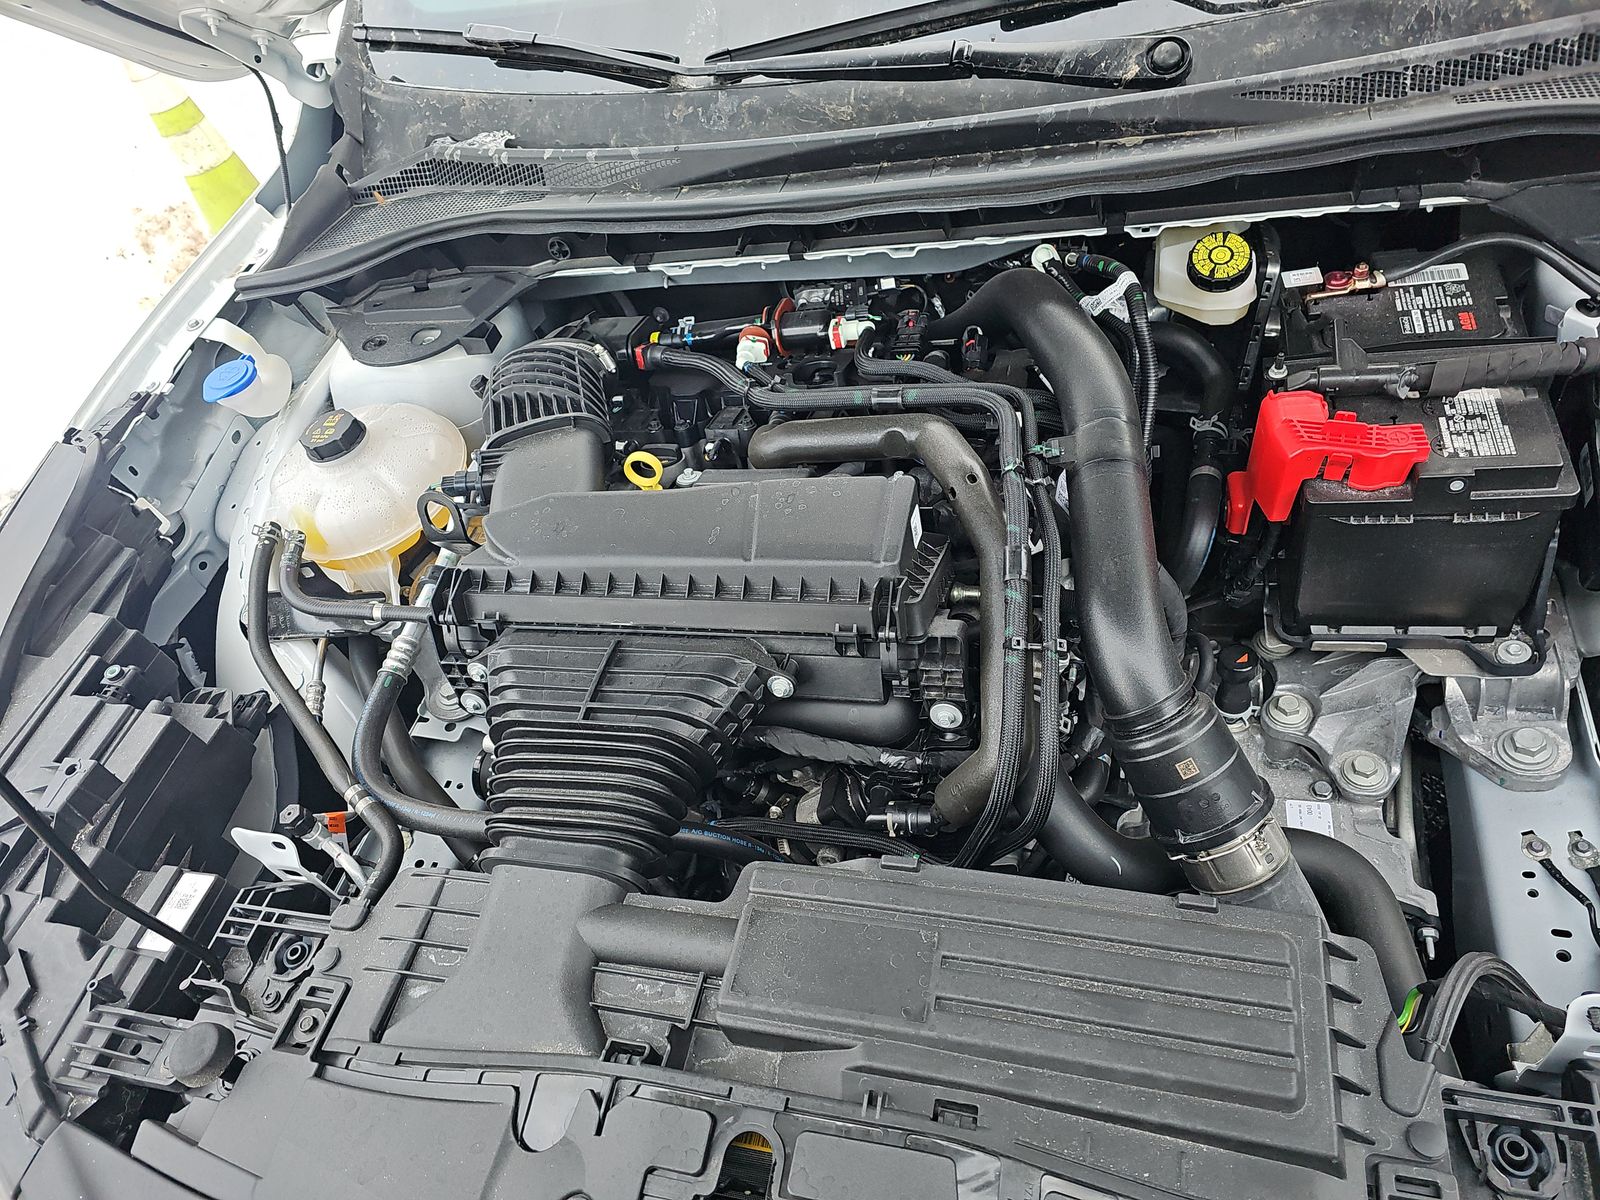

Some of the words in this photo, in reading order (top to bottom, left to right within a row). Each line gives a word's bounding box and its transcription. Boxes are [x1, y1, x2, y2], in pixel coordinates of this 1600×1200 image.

[1457, 312, 1473, 331] AGM
[703, 830, 731, 841] SUCTION
[731, 836, 748, 847] HOSE
